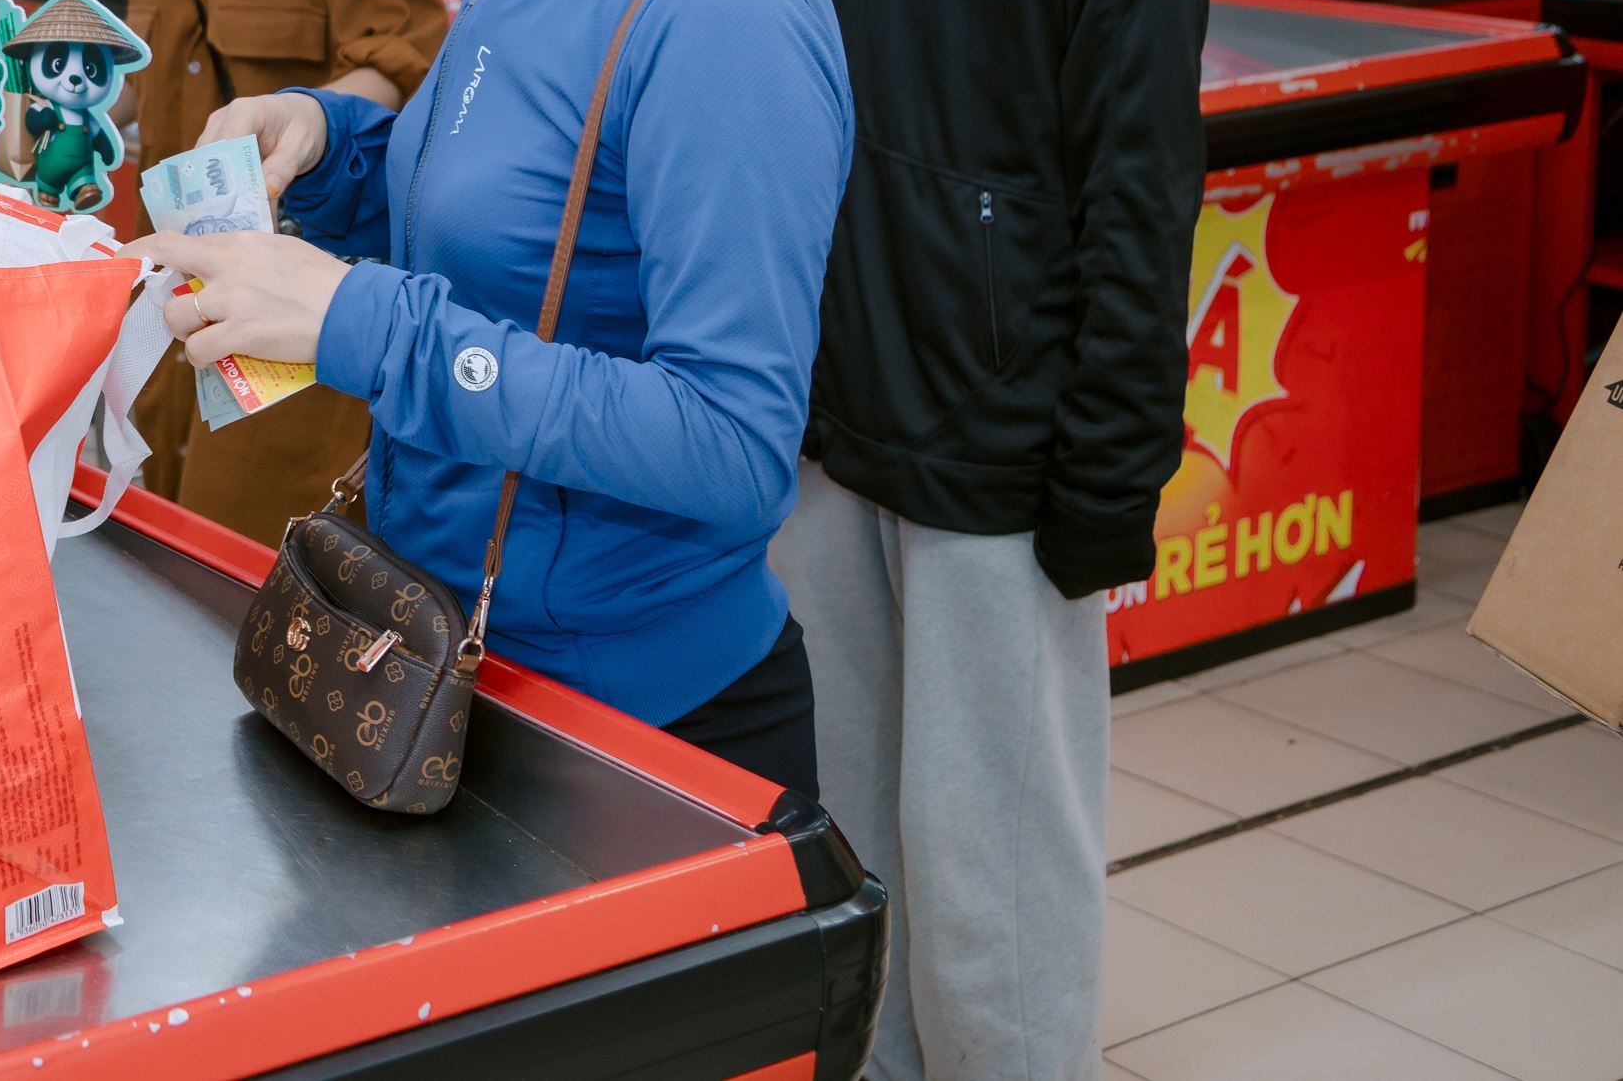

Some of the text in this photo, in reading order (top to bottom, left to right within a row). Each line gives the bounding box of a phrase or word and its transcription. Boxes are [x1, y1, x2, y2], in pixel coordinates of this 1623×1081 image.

[232, 377, 250, 397] NỘI
[1154, 489, 1354, 601] RẺ HƠN
[300, 662, 319, 703] MEIXING
[374, 709, 396, 752] MEIXING
